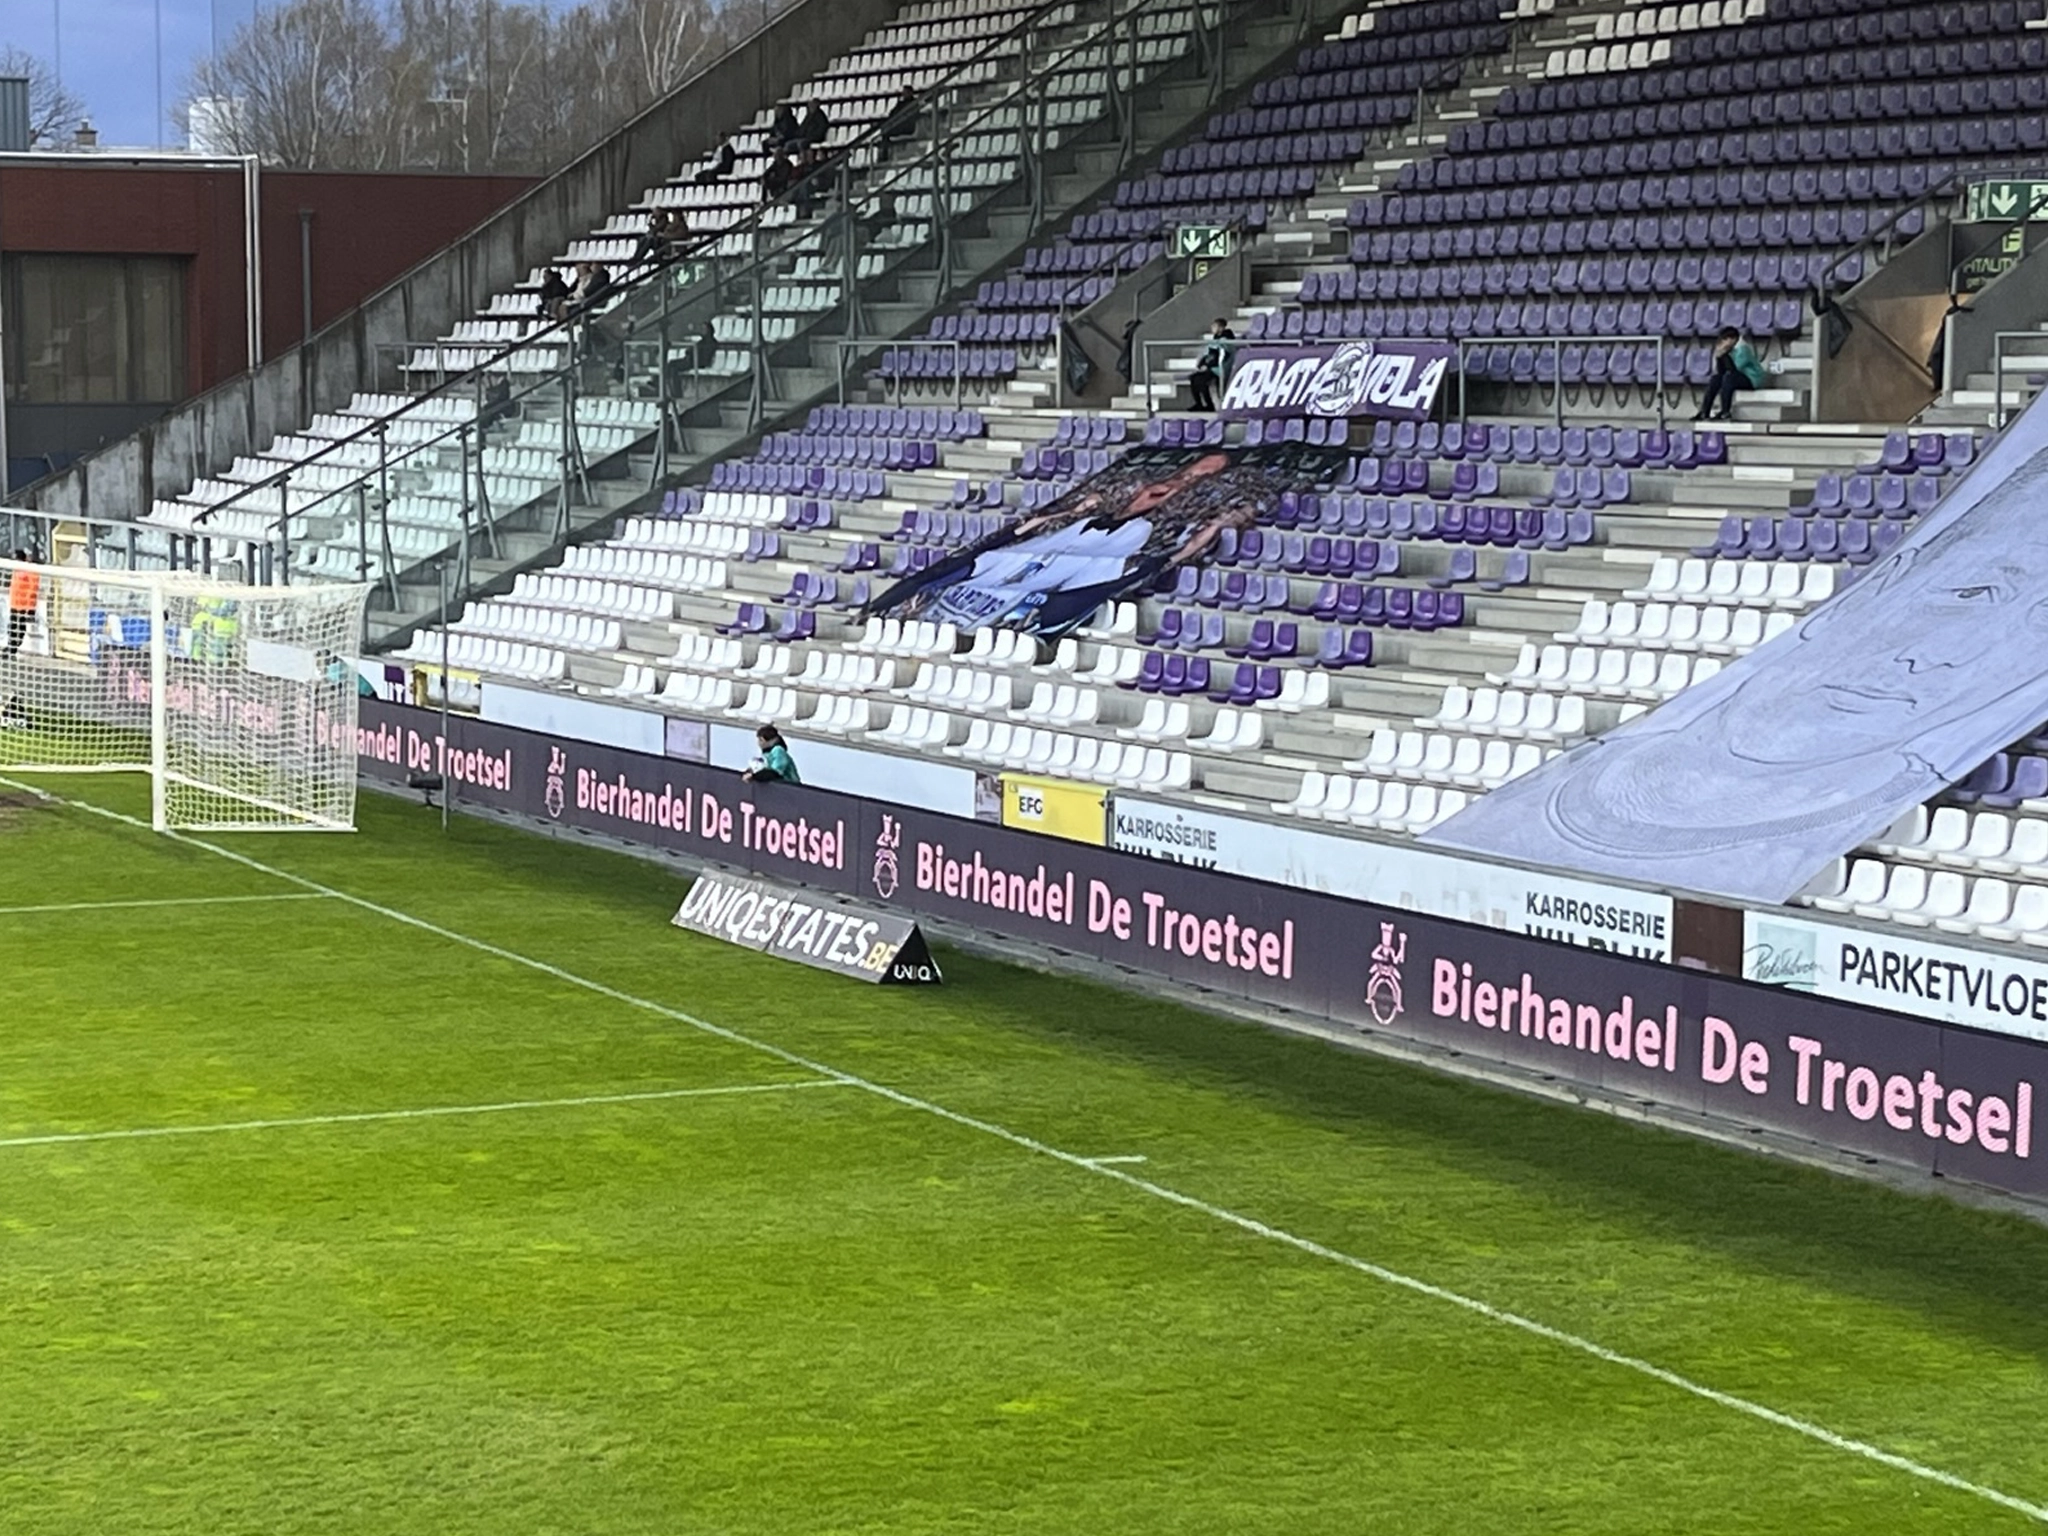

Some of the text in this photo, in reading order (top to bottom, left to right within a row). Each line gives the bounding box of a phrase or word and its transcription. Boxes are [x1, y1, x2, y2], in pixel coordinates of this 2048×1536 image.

[1221, 354, 1448, 410] ARMATA VIOLA
[408, 730, 431, 773] De
[435, 736, 511, 791] Troetsel
[577, 768, 844, 870] Bierhandel De Troetsel
[1116, 814, 1217, 851] KARROSSERIE
[915, 842, 1294, 979] Bierhandel De Troetsel
[1526, 891, 1665, 940] KARROSSERIE
[1840, 943, 2048, 1021] PARKETVLOE
[1431, 957, 2033, 1158] Bierhandel De Troetsel
